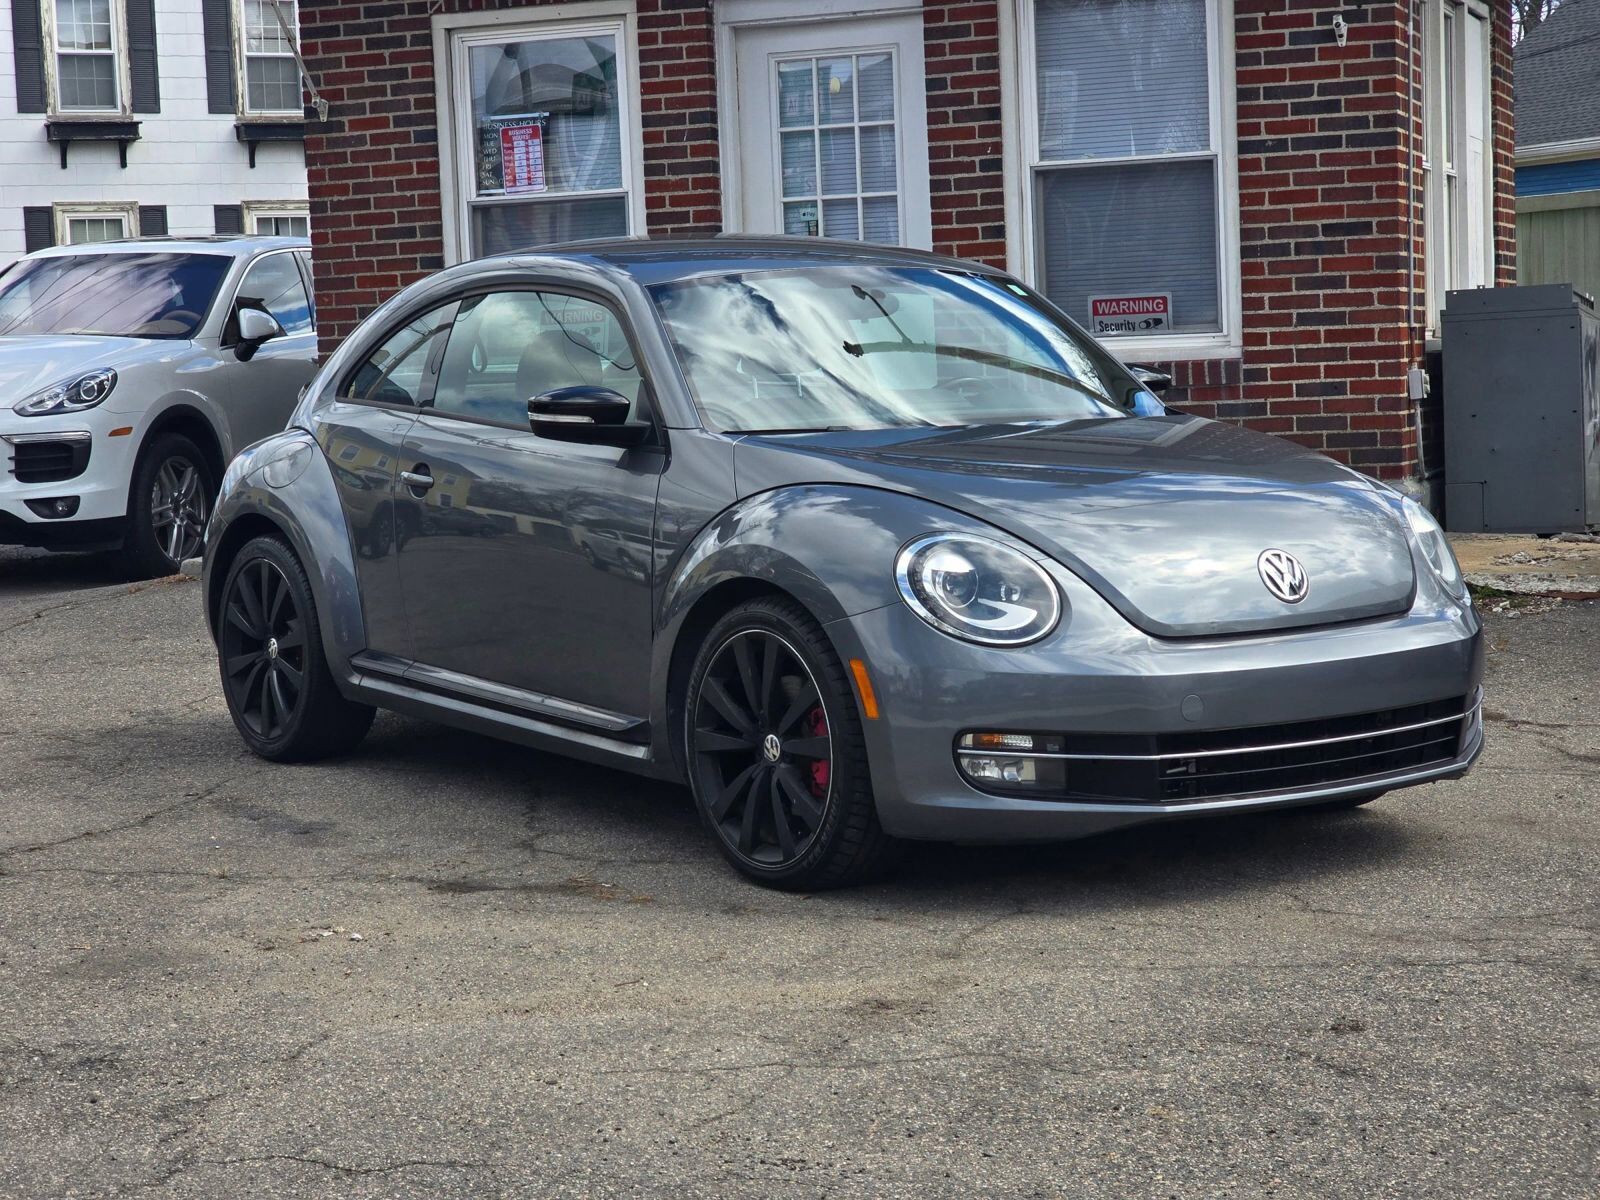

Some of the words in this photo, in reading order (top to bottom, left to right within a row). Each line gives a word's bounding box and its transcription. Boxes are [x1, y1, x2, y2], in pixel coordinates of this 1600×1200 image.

[1097, 299, 1164, 314] WARNING
[544, 310, 602, 323] WARNING
[1098, 319, 1136, 332] Security
[1259, 549, 1308, 602] VW
